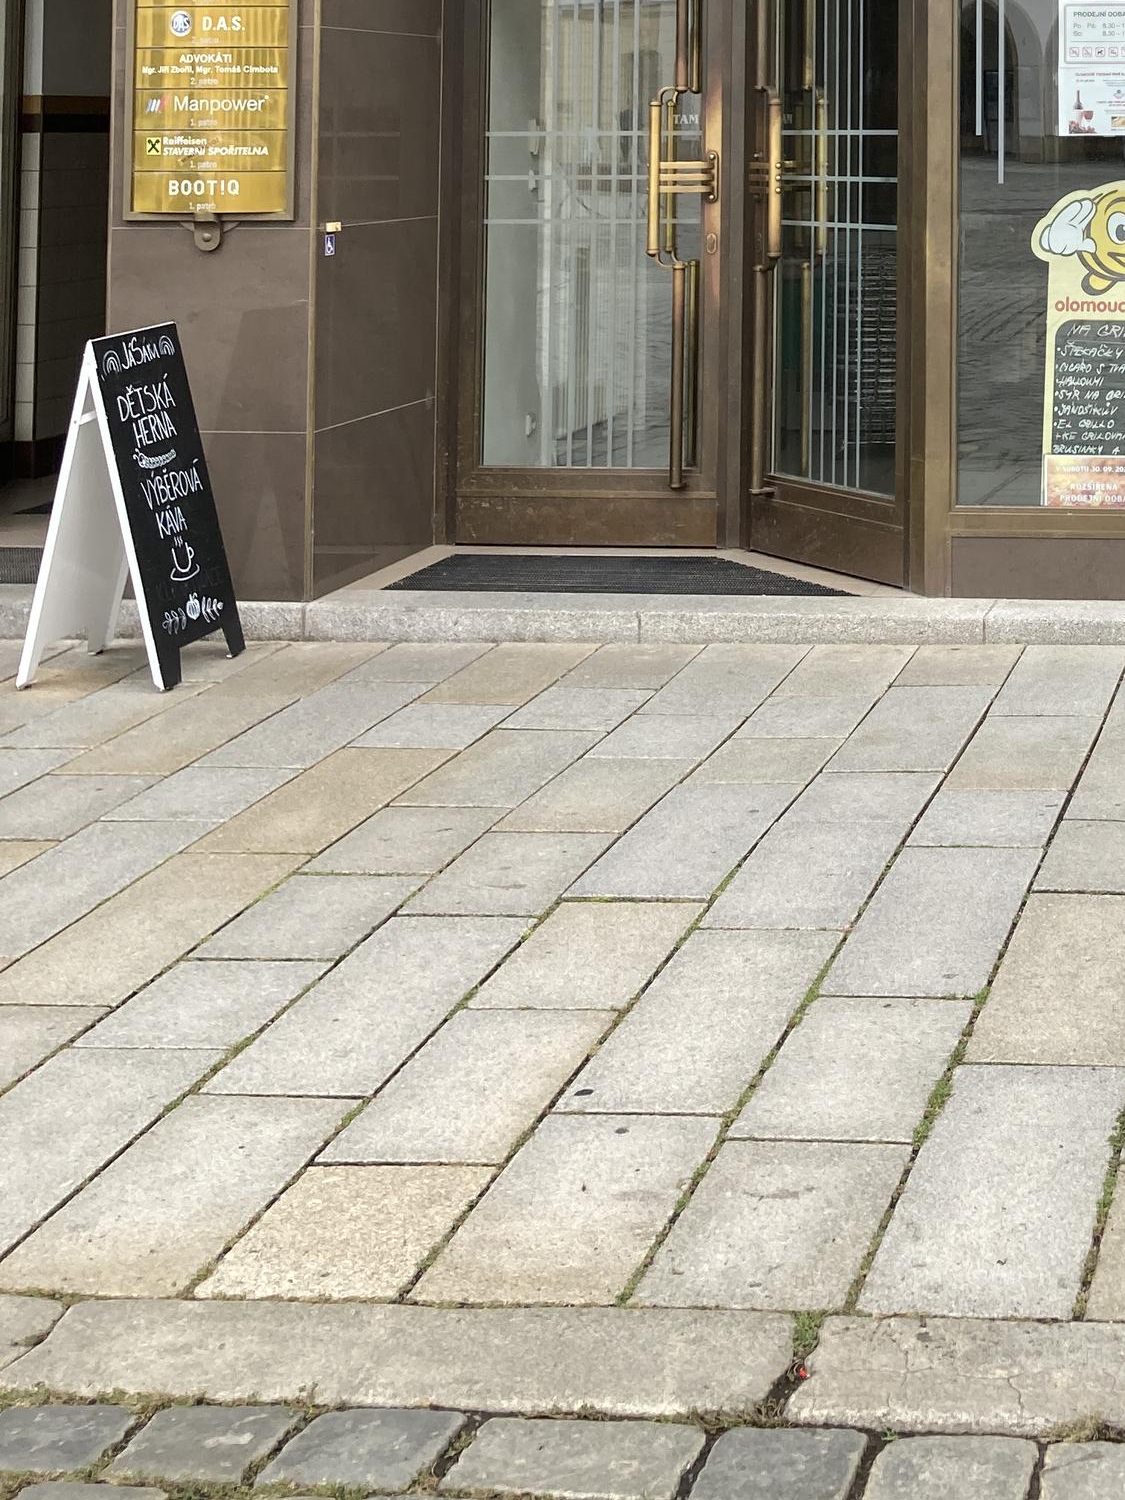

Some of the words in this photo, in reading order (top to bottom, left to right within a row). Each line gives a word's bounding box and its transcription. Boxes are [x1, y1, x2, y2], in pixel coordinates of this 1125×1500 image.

[202, 16, 245, 31] D.A.S.
[179, 52, 232, 63] ADVOKÁTI
[196, 66, 213, 75] Mgr.
[174, 95, 266, 114] Manpower
[673, 113, 699, 125] TAM
[163, 136, 207, 145] Raiffeisen
[207, 145, 269, 155] SPOŘITELNA
[1067, 324, 1092, 337] NA
[117, 372, 176, 422] DĚTSKÁ
[132, 411, 177, 448] HERNA
[141, 458, 203, 510] VÝBĚROVÁ
[155, 505, 187, 539] KÁVA
